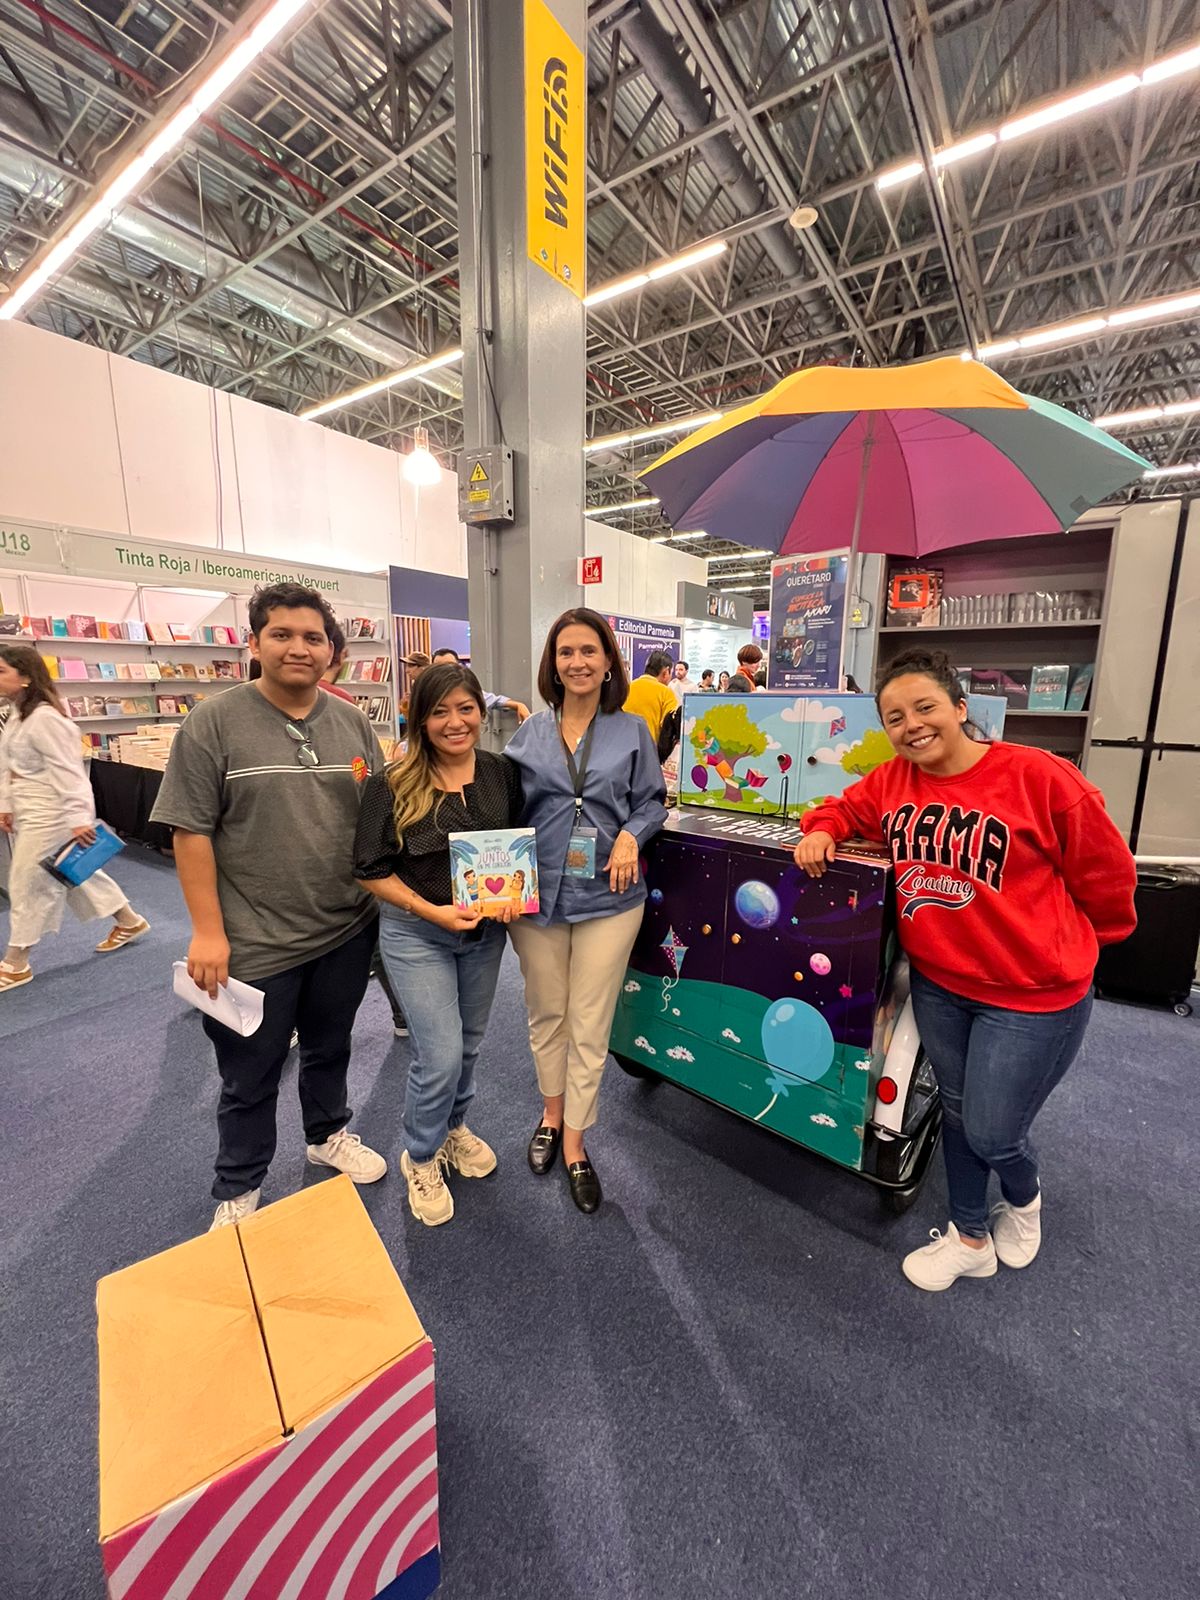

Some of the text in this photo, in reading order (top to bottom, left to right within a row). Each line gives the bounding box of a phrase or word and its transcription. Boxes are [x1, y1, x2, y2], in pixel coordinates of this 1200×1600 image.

[116, 548, 154, 567] Tinta
[159, 554, 191, 574] Roja
[203, 560, 294, 583] Iberoamericana
[298, 573, 340, 592] Vervuert
[786, 572, 831, 587] QUERÉTARO
[619, 619, 647, 634] Editorial
[647, 624, 675, 638] Parmenia
[697, 814, 735, 823] MI
[711, 825, 799, 842] AKARI
[896, 865, 976, 903] Loading
